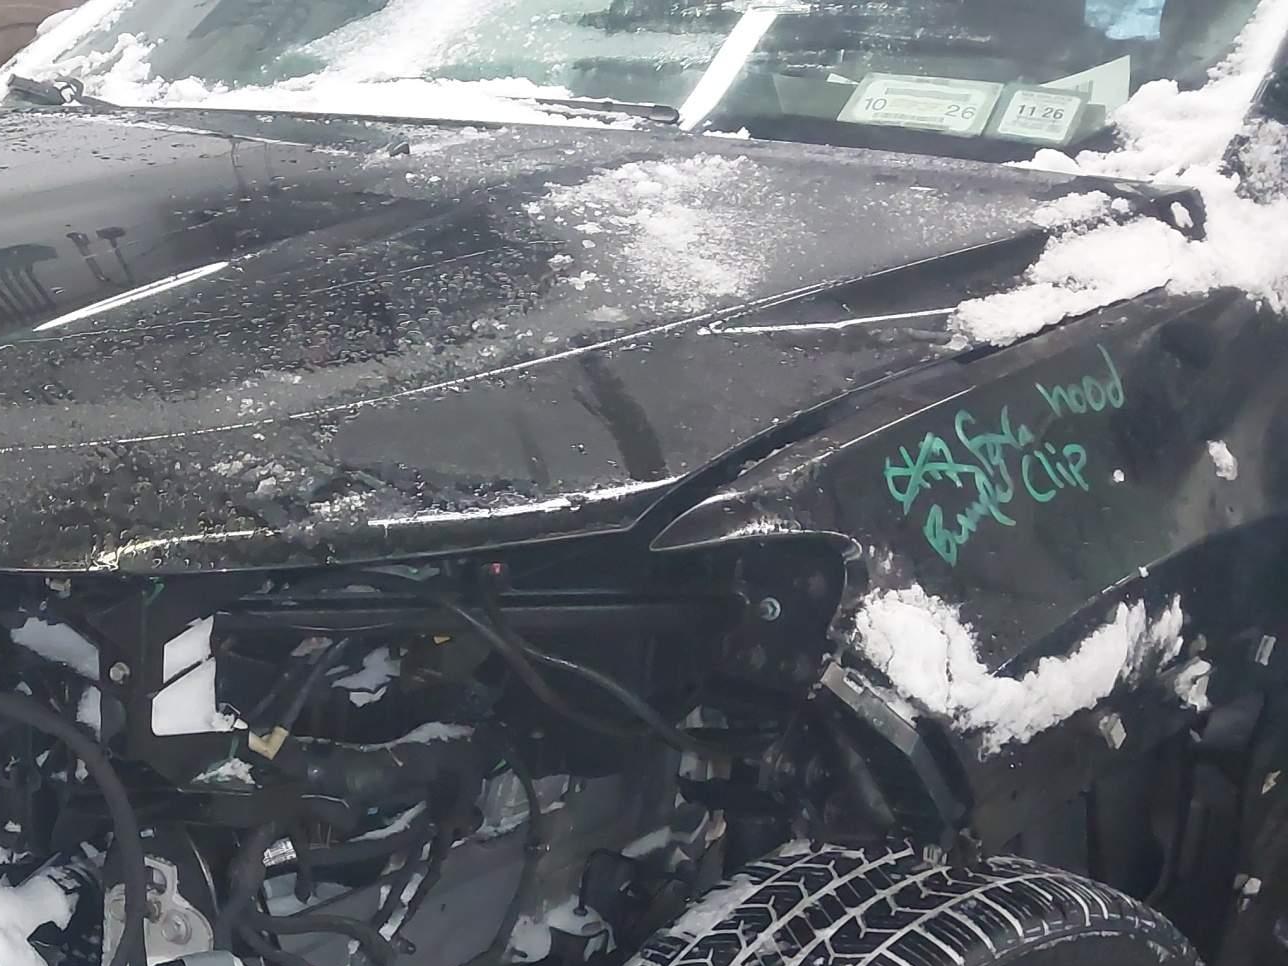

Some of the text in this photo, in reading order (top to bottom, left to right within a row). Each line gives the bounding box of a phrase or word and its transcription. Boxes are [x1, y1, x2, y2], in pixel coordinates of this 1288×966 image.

[864, 97, 887, 112] 10
[944, 104, 977, 120] 26
[1017, 104, 1064, 120] 11 26
